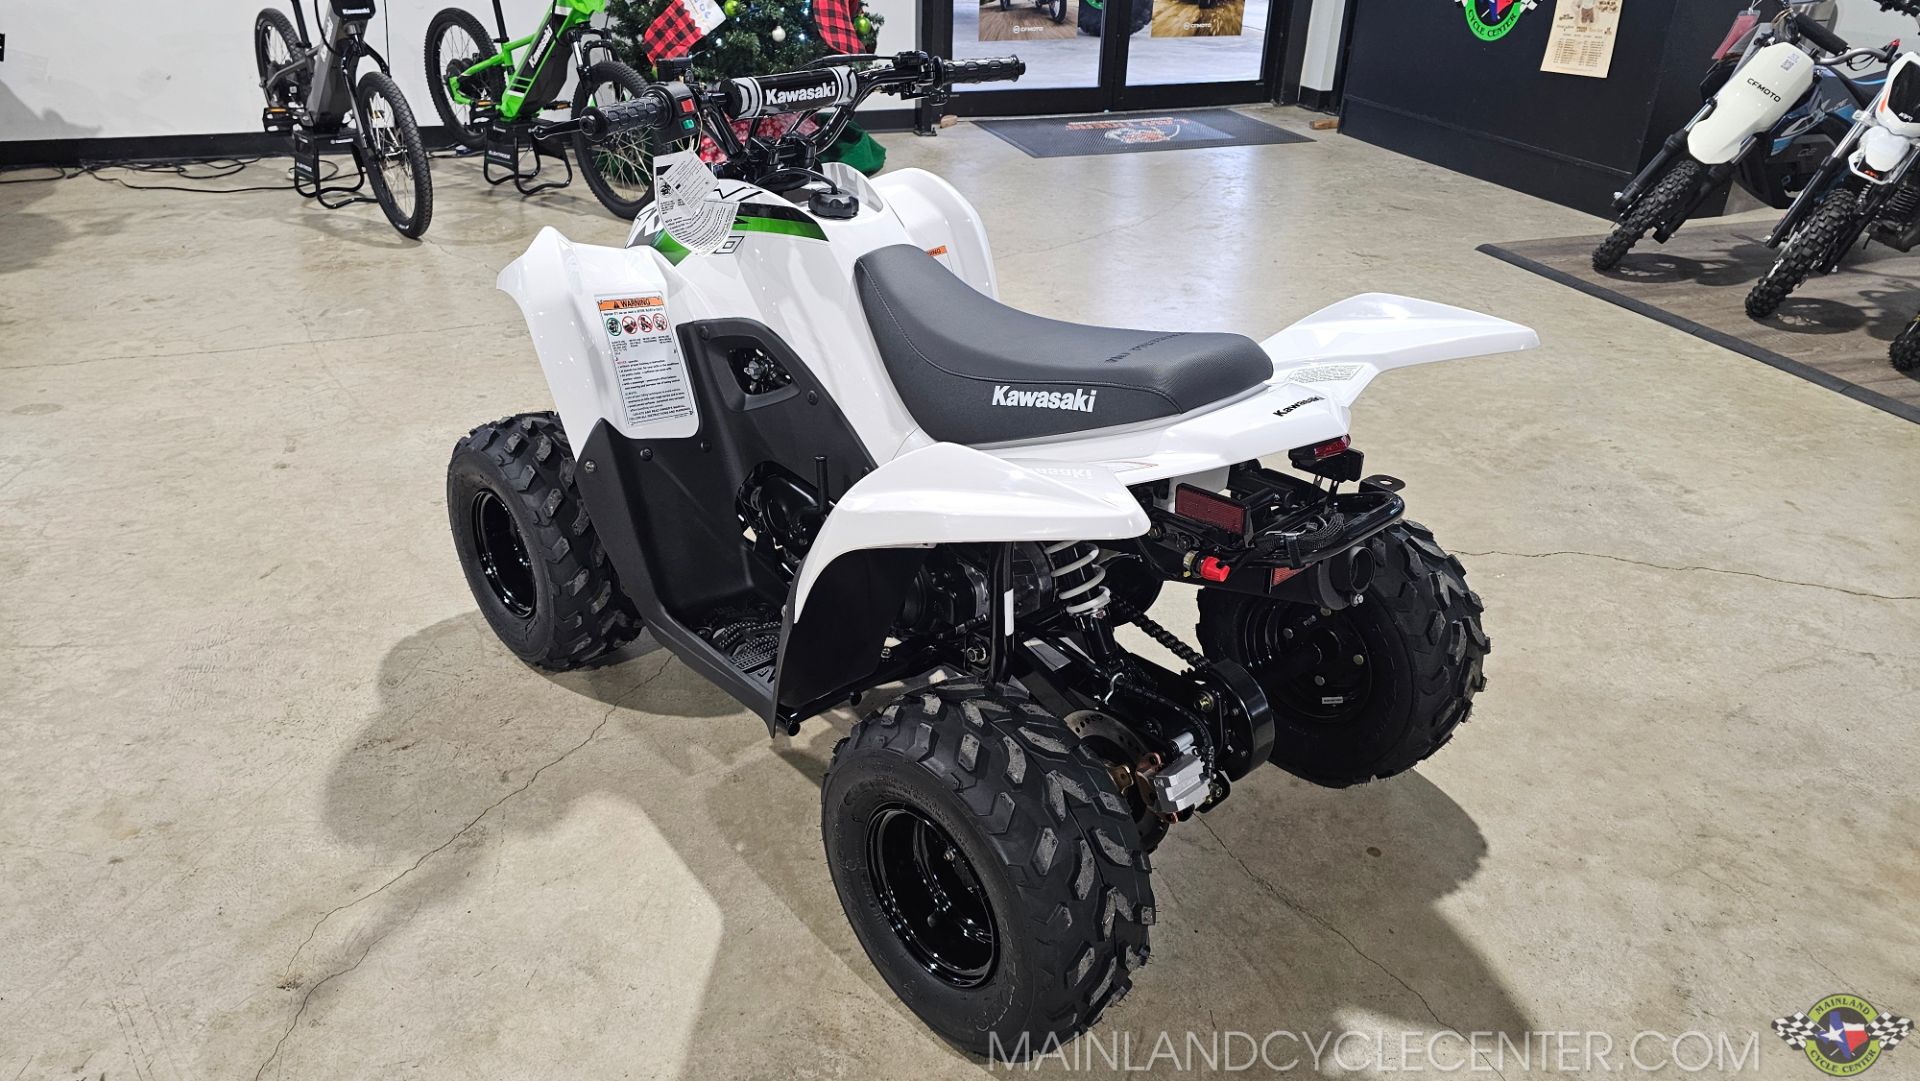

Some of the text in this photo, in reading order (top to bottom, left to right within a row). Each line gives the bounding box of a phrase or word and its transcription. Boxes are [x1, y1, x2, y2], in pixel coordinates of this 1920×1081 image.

[1468, 8, 1516, 38] CYCLE CENTER
[765, 81, 836, 106] Kawasaki
[1746, 78, 1782, 103] CFMOTO
[621, 298, 651, 309] WARNING
[992, 385, 1098, 413] Kawasaki
[1272, 395, 1324, 417] Kawasaki
